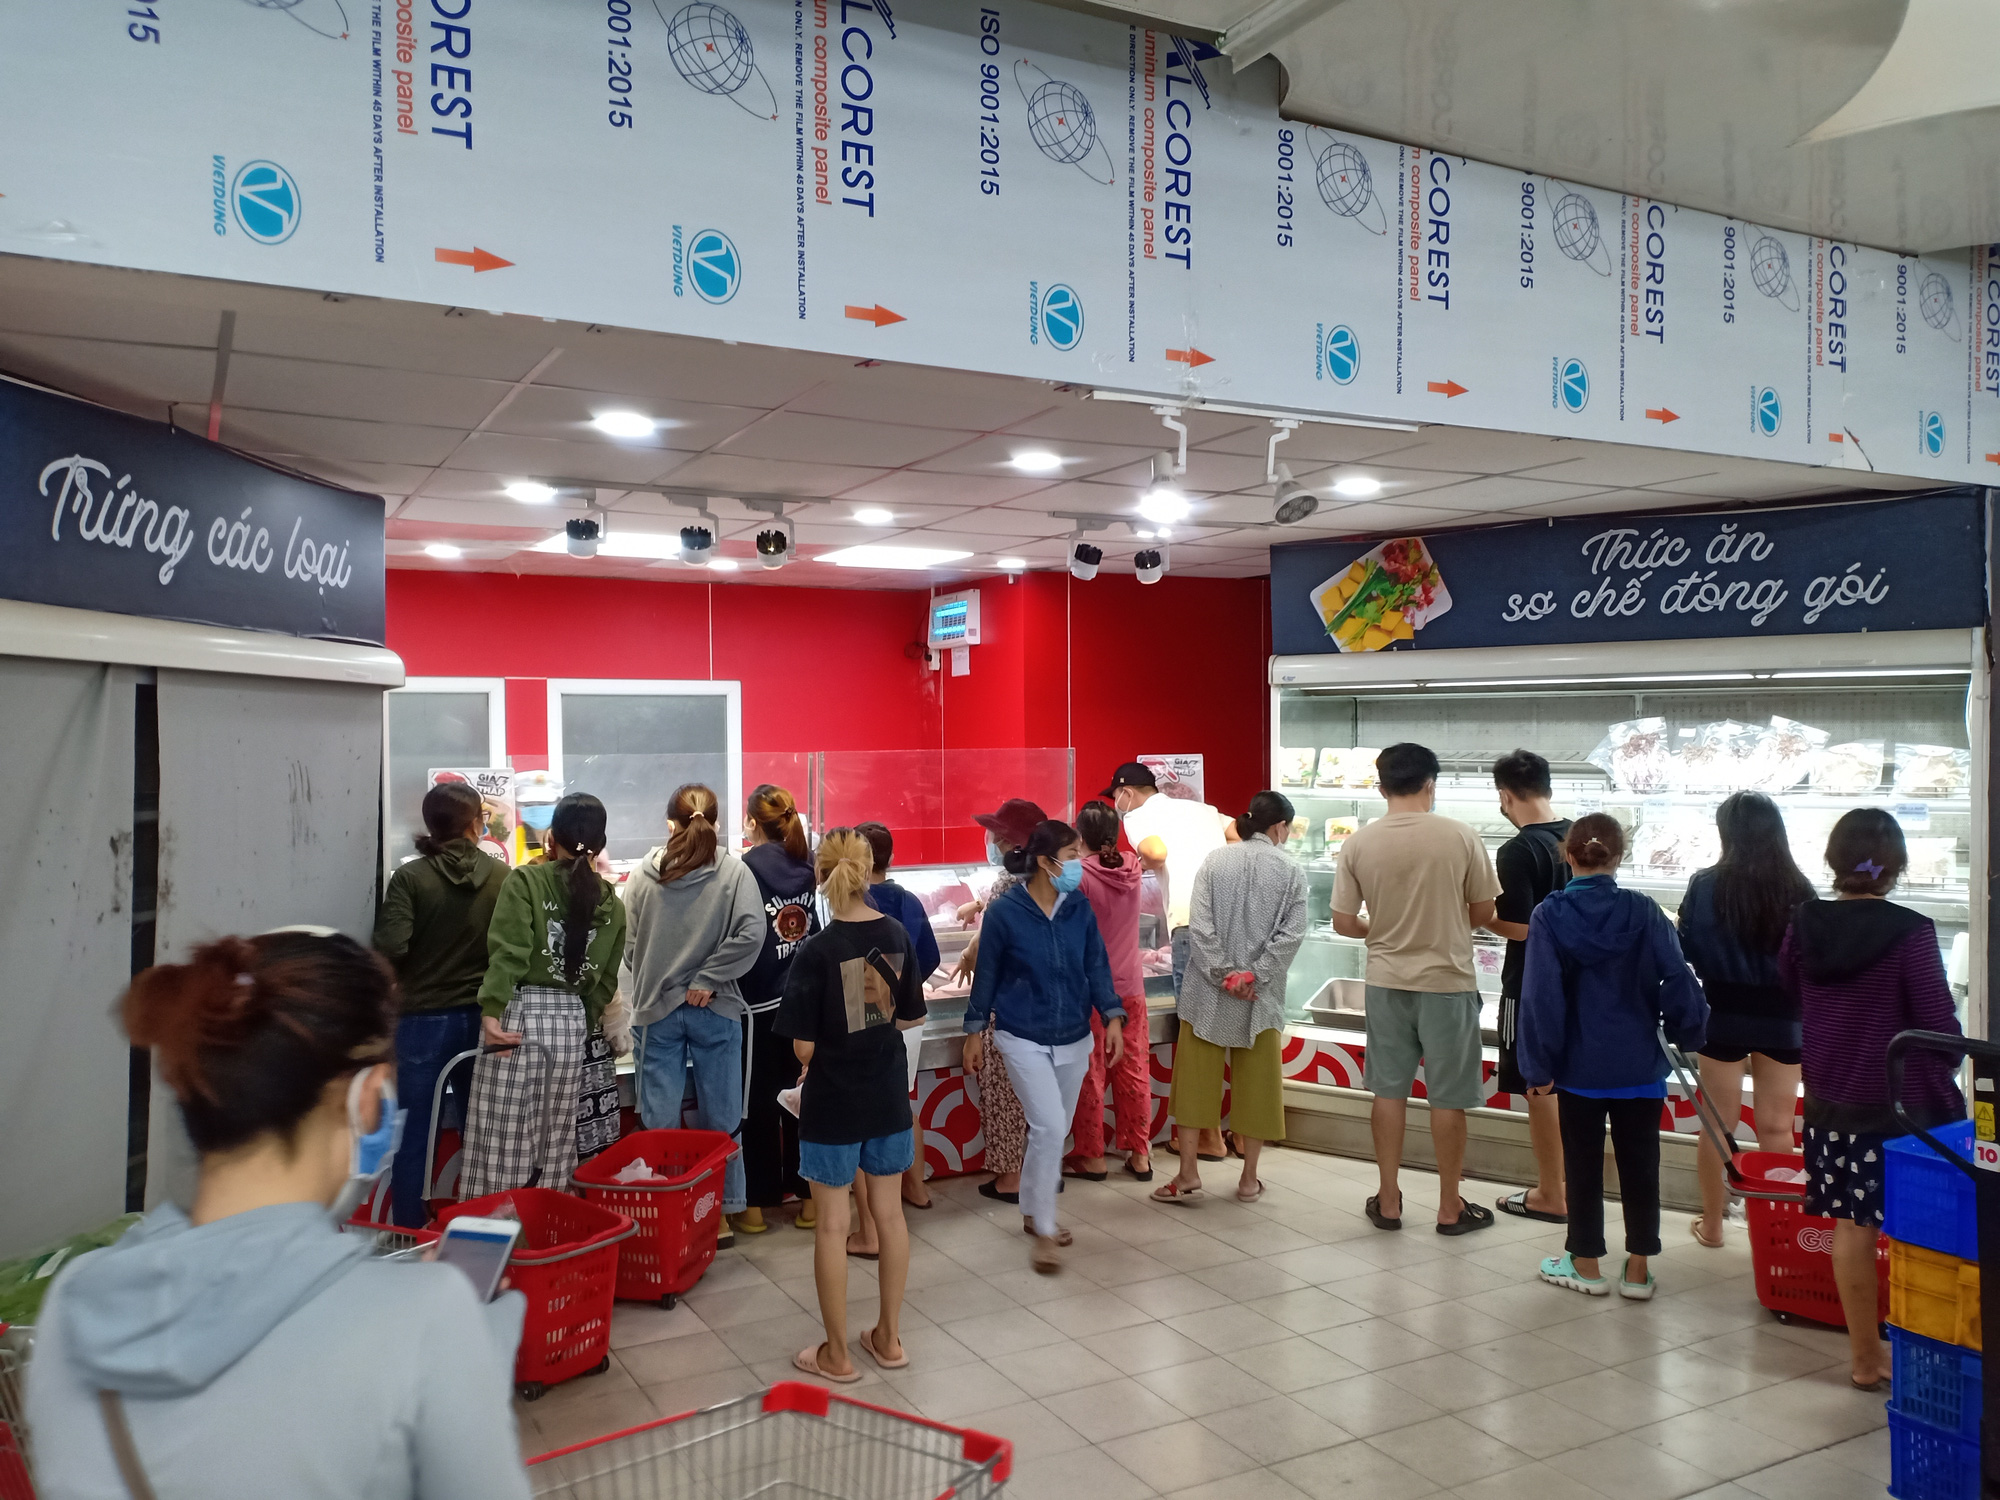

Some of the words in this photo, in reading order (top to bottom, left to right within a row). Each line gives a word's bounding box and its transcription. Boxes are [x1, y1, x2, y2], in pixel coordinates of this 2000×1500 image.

[127, 0, 161, 44] 15
[371, 5, 382, 27] THE
[372, 30, 382, 56] FILM
[979, 8, 1000, 55] ISO
[372, 59, 383, 96] WITHIN
[795, 43, 804, 87] REMOVE
[1129, 34, 1137, 83] DIRECTION
[372, 99, 383, 112] 45
[391, 69, 419, 135] panel
[795, 89, 804, 110] THE
[811, 35, 831, 141] composite
[840, 0, 885, 218] LCOREST
[373, 114, 384, 144] DAYS
[796, 112, 804, 135] FILM
[979, 63, 1000, 195] 9001:2015
[373, 146, 384, 183] AFTER
[796, 138, 805, 171] WITHIN
[796, 174, 805, 186] 45
[811, 146, 832, 205] panel
[1141, 107, 1158, 202] composite
[212, 154, 227, 237] VIETDUNG
[796, 187, 805, 214] DAYS
[1277, 128, 1294, 248] 9001:2015
[1408, 165, 1422, 250] composite
[374, 184, 385, 263] INSTALLATION
[797, 216, 806, 248] AFTER
[1128, 232, 1135, 243] 45
[1140, 208, 1158, 259] panel
[1427, 150, 1451, 310] COREST
[1519, 181, 1535, 289] 9001:2015
[1629, 212, 1642, 290] composite
[672, 224, 684, 298] VIETDUNG
[798, 251, 808, 320] INSTALLATION
[1408, 255, 1422, 301] panel
[1645, 199, 1665, 344] COREST
[1723, 225, 1736, 324] 9001:2015
[1815, 253, 1825, 324] composite
[1030, 280, 1040, 345] VIETDUNG
[1128, 300, 1136, 363] INSTALLATION
[1628, 294, 1641, 336] panel
[1828, 240, 1847, 373] COREST
[1896, 264, 1907, 354] 9001:2015
[1315, 322, 1325, 380] VIETDUNG
[1814, 328, 1824, 366] panel
[1974, 356, 1983, 392] panel
[1551, 356, 1559, 409] VIETDUNG
[38, 453, 194, 585] Trứng
[206, 506, 274, 574] các
[284, 516, 352, 596] loại
[1581, 528, 1691, 575] Thức
[1705, 523, 1774, 563] ăn
[1570, 571, 1653, 619] chế
[1660, 571, 1789, 627] đóng
[1801, 562, 1890, 625] gói
[1977, 1146, 1998, 1163] 10
